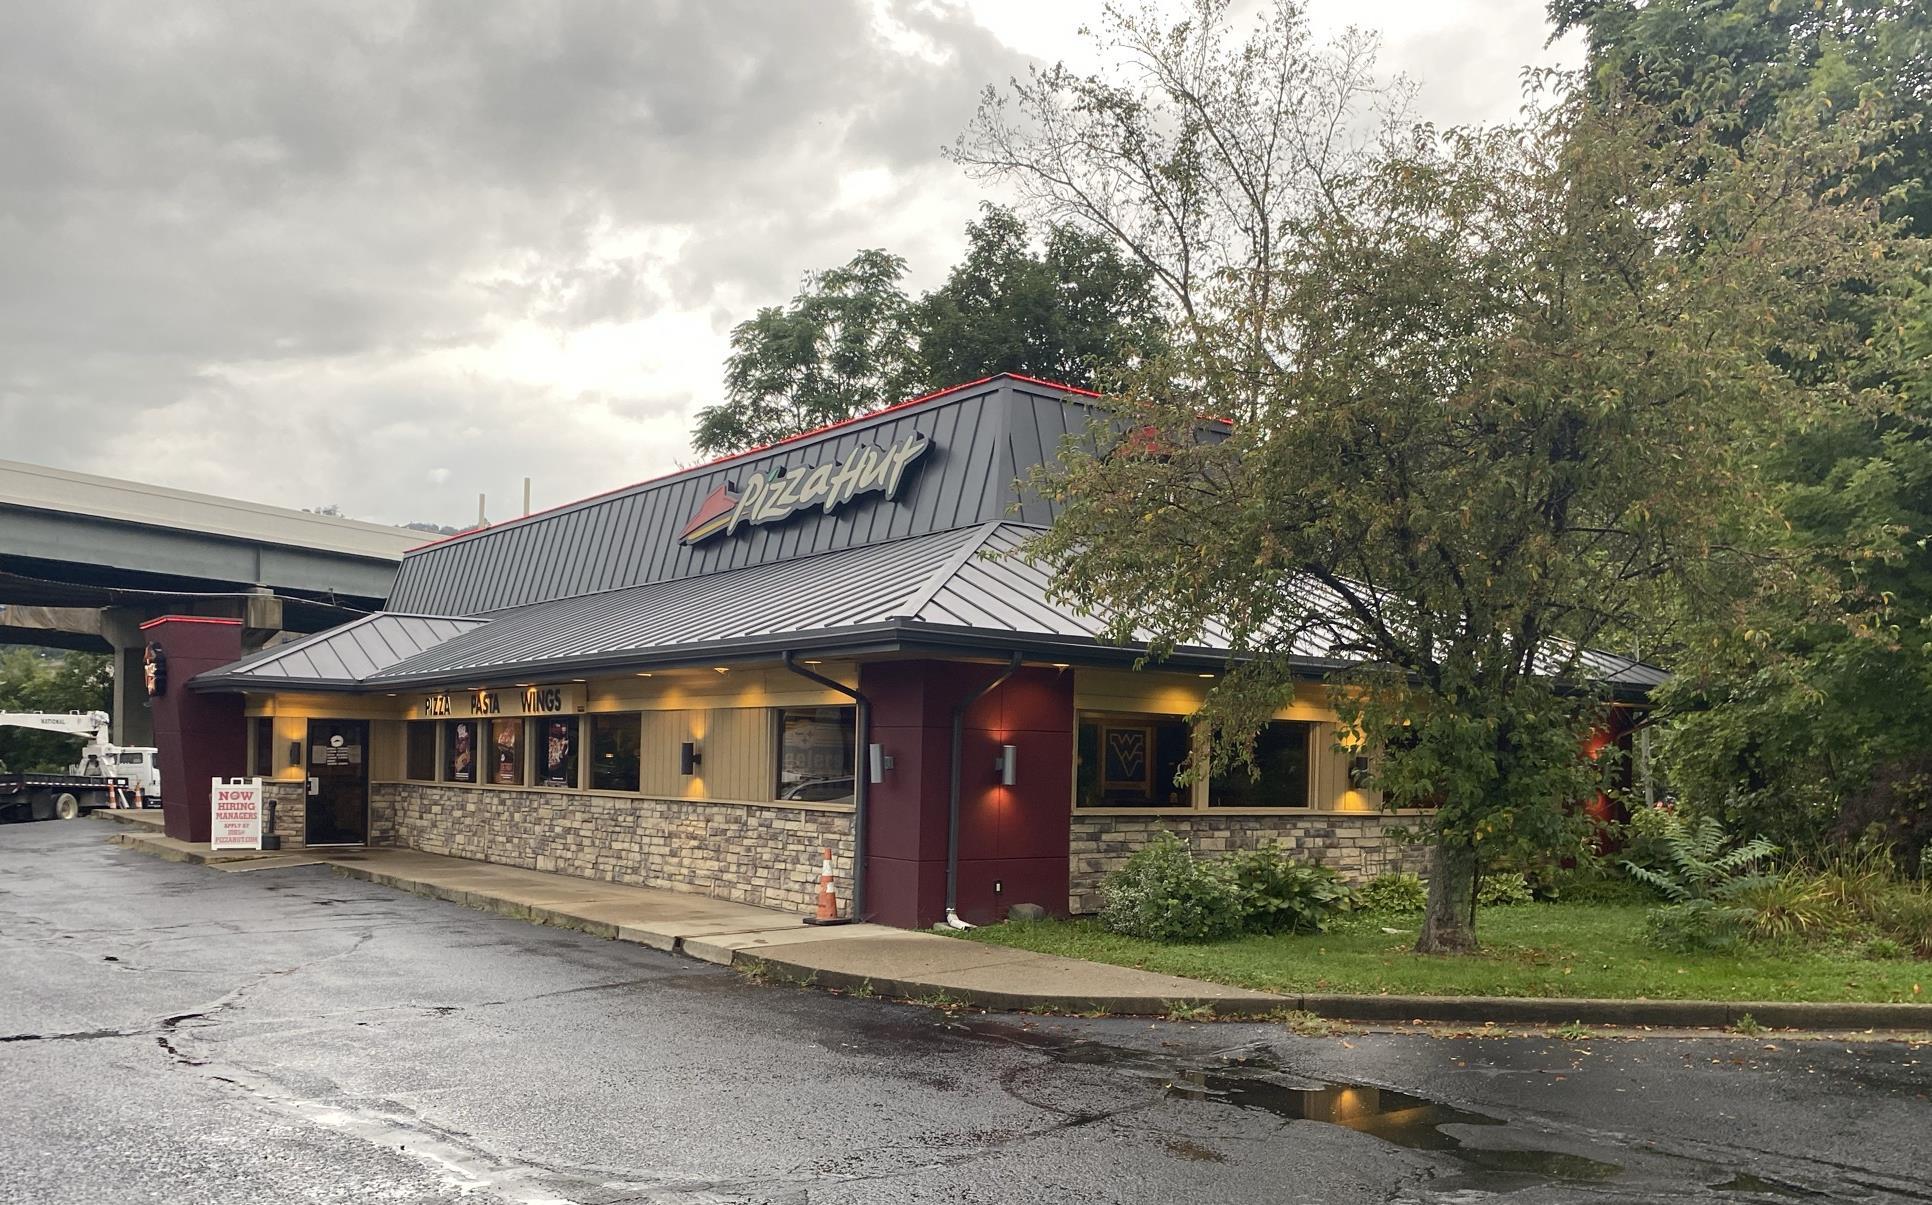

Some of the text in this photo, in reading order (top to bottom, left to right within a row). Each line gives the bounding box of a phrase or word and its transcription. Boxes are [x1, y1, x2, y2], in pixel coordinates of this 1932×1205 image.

[425, 688, 562, 716] PIZZA PASTA WINGS
[218, 791, 254, 801] NOW
[217, 802, 256, 811] HIRING
[215, 812, 258, 820] MANAGERS
